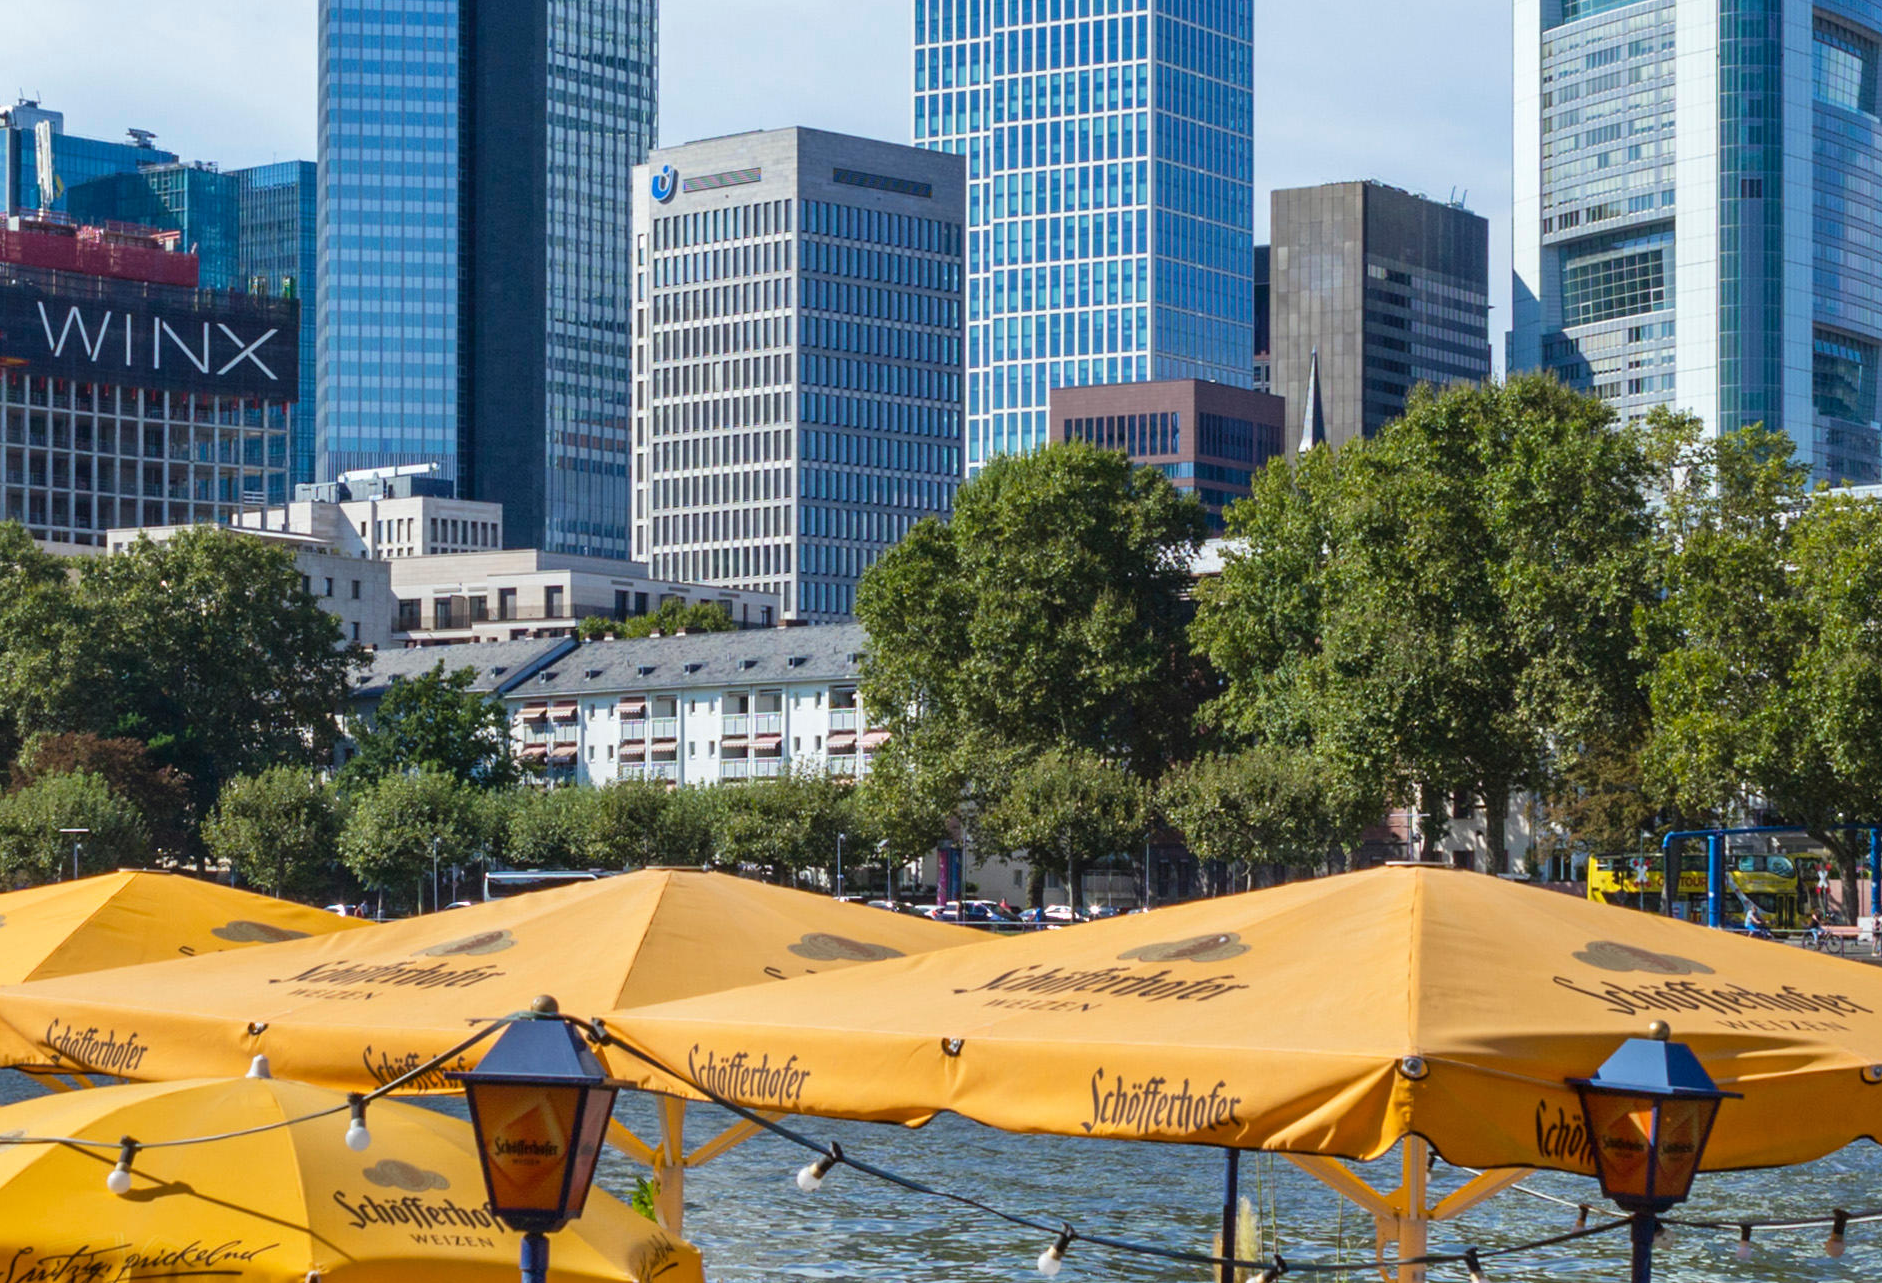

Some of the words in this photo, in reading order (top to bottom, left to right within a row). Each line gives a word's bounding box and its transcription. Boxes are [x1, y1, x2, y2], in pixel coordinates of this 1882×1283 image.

[37, 301, 278, 380] WINX
[953, 964, 1250, 1003] Schöfferhofer
[1552, 975, 1875, 1018] Schöfferhofer
[1716, 1019, 1852, 1032] WEIZEN
[1080, 1066, 1242, 1135] Schöfferhofer
[410, 1232, 495, 1249] WEIZEN
